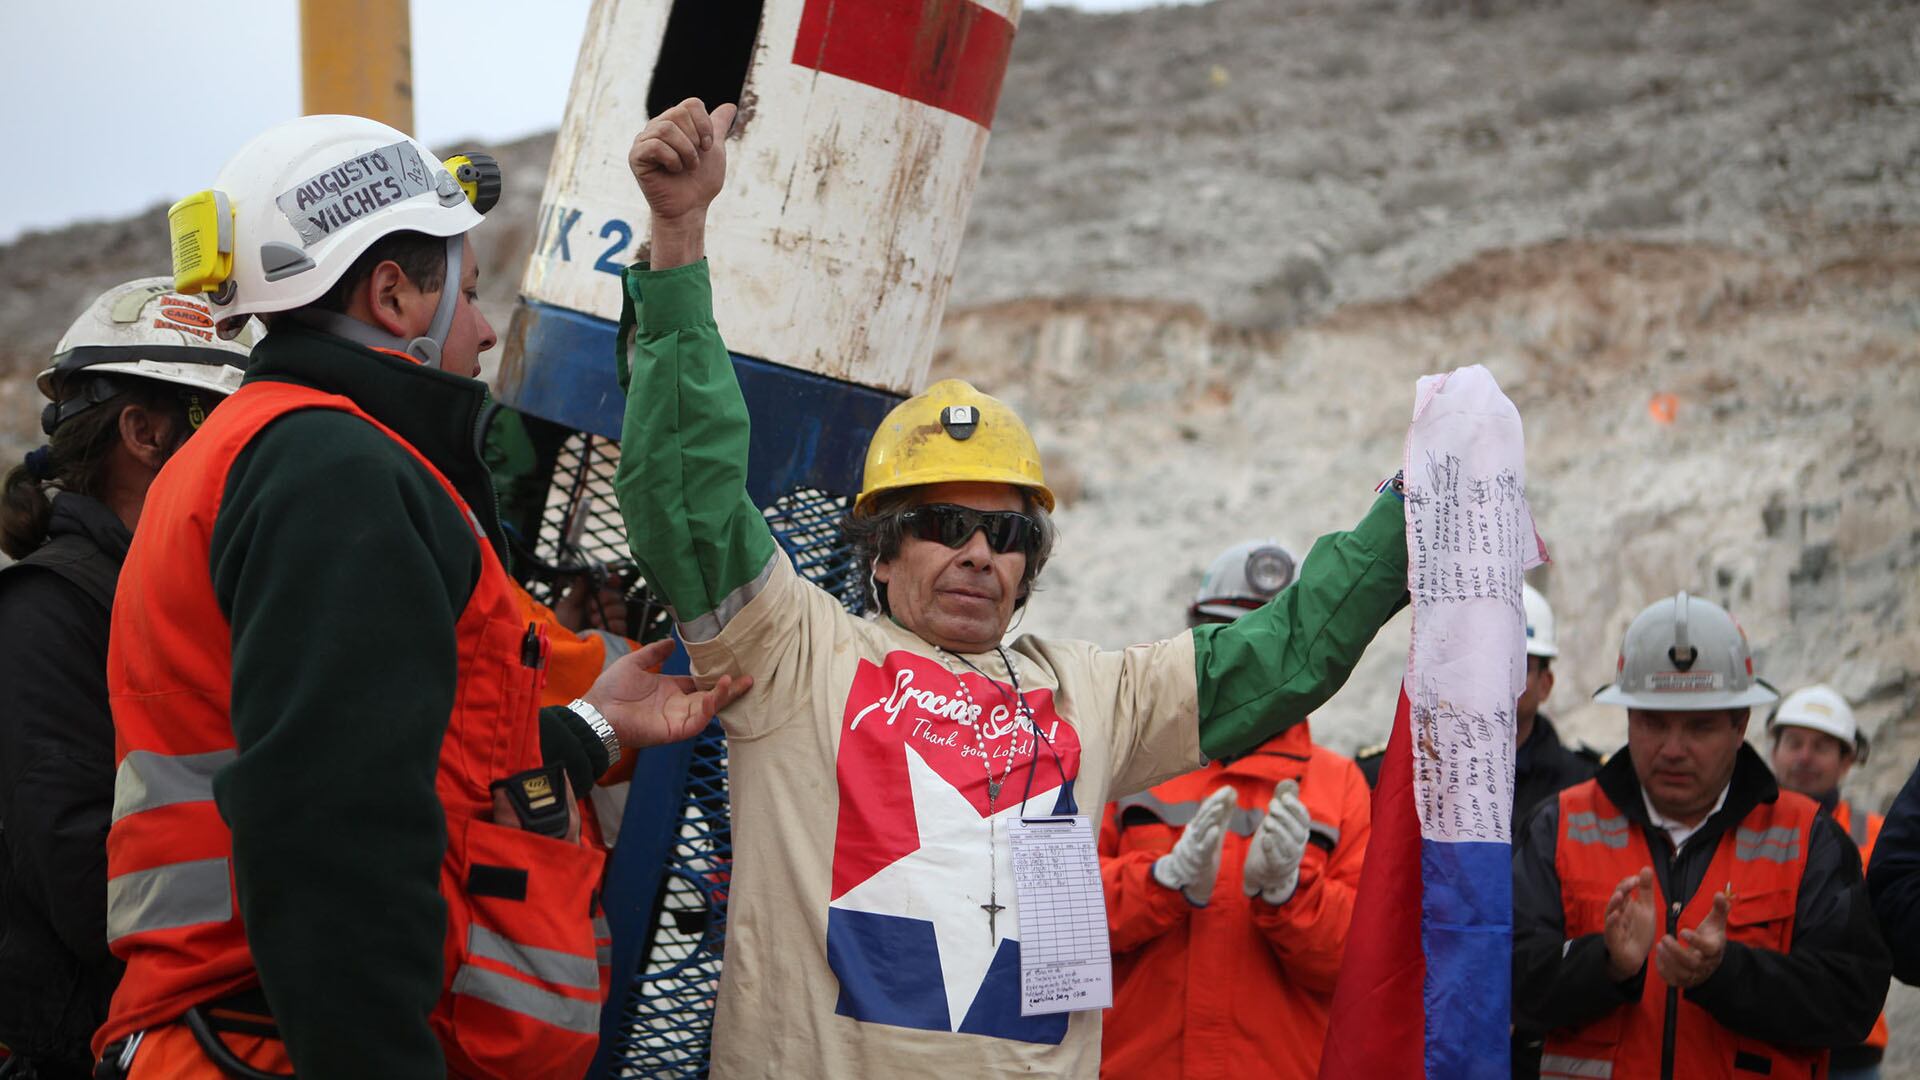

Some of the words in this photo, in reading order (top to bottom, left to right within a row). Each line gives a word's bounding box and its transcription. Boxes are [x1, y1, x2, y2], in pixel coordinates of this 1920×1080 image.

[296, 152, 390, 211] AUGUSTO
[309, 176, 402, 233] VILCHES
[593, 218, 632, 277] 2
[167, 309, 210, 325] CAROLA
[912, 717, 959, 747] Thank
[961, 742, 986, 757] you
